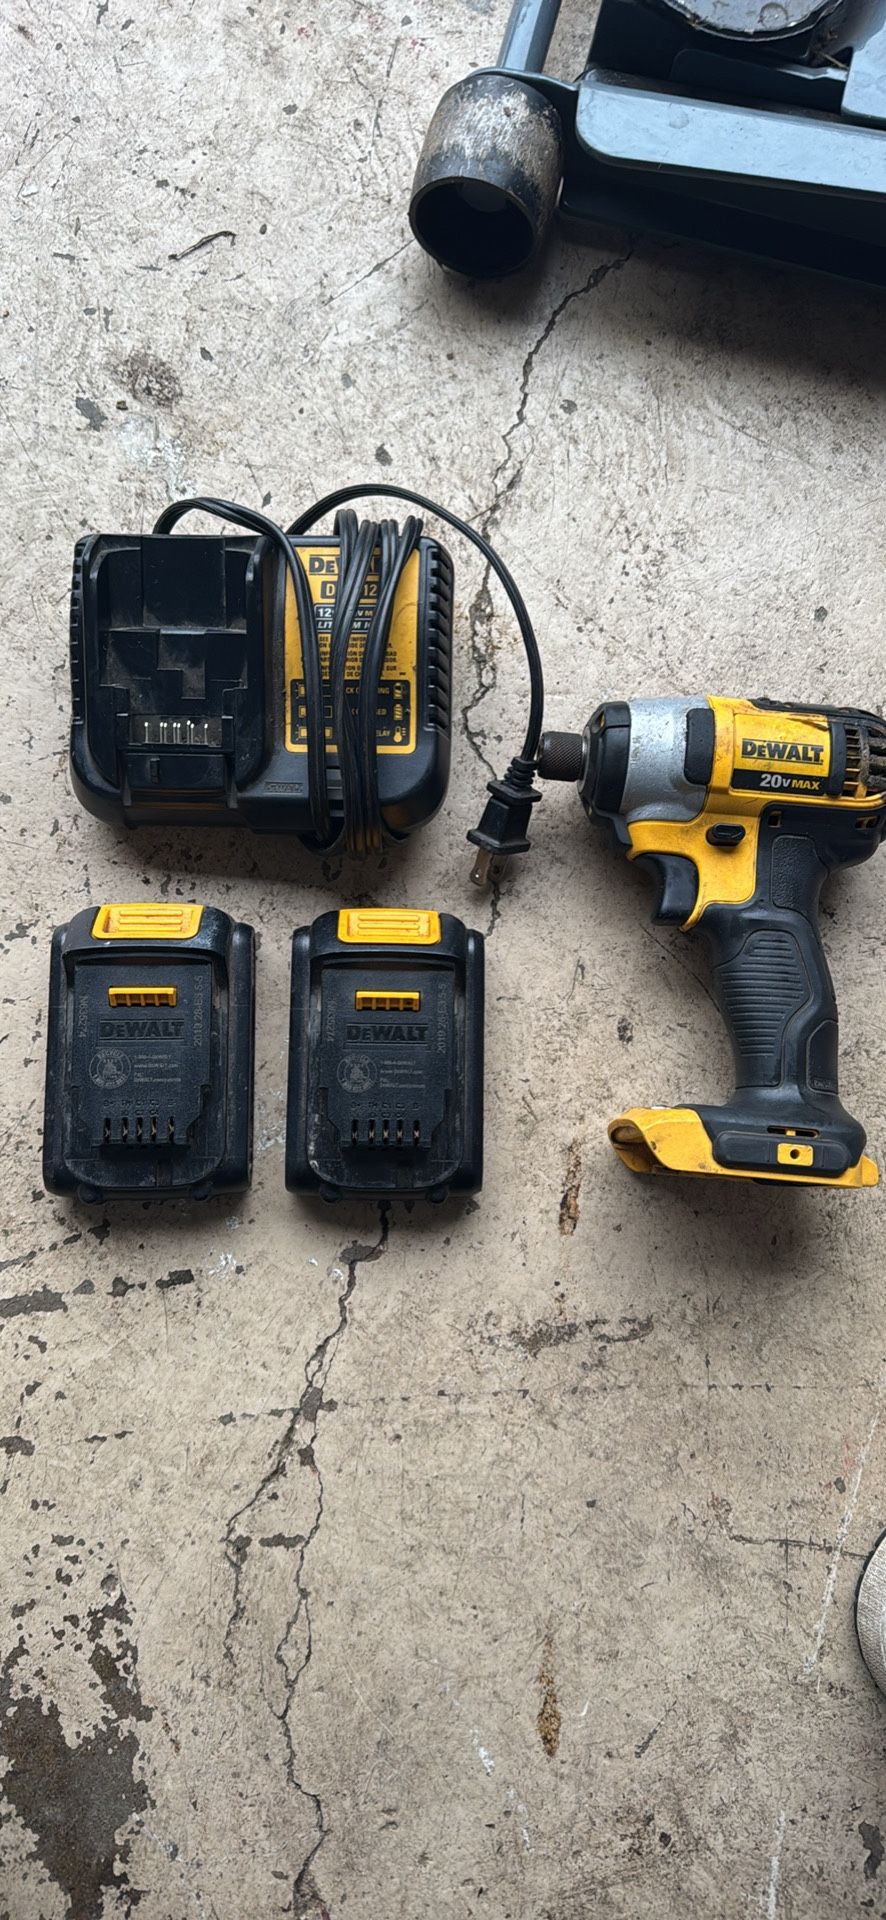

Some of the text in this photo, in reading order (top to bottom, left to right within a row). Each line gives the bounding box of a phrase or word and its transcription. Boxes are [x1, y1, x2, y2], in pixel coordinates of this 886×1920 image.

[741, 739, 824, 763] DEWALT
[760, 773, 820, 790] 20V MAX
[100, 1020, 184, 1040] DEWALT
[346, 1024, 428, 1043] DEWALT
